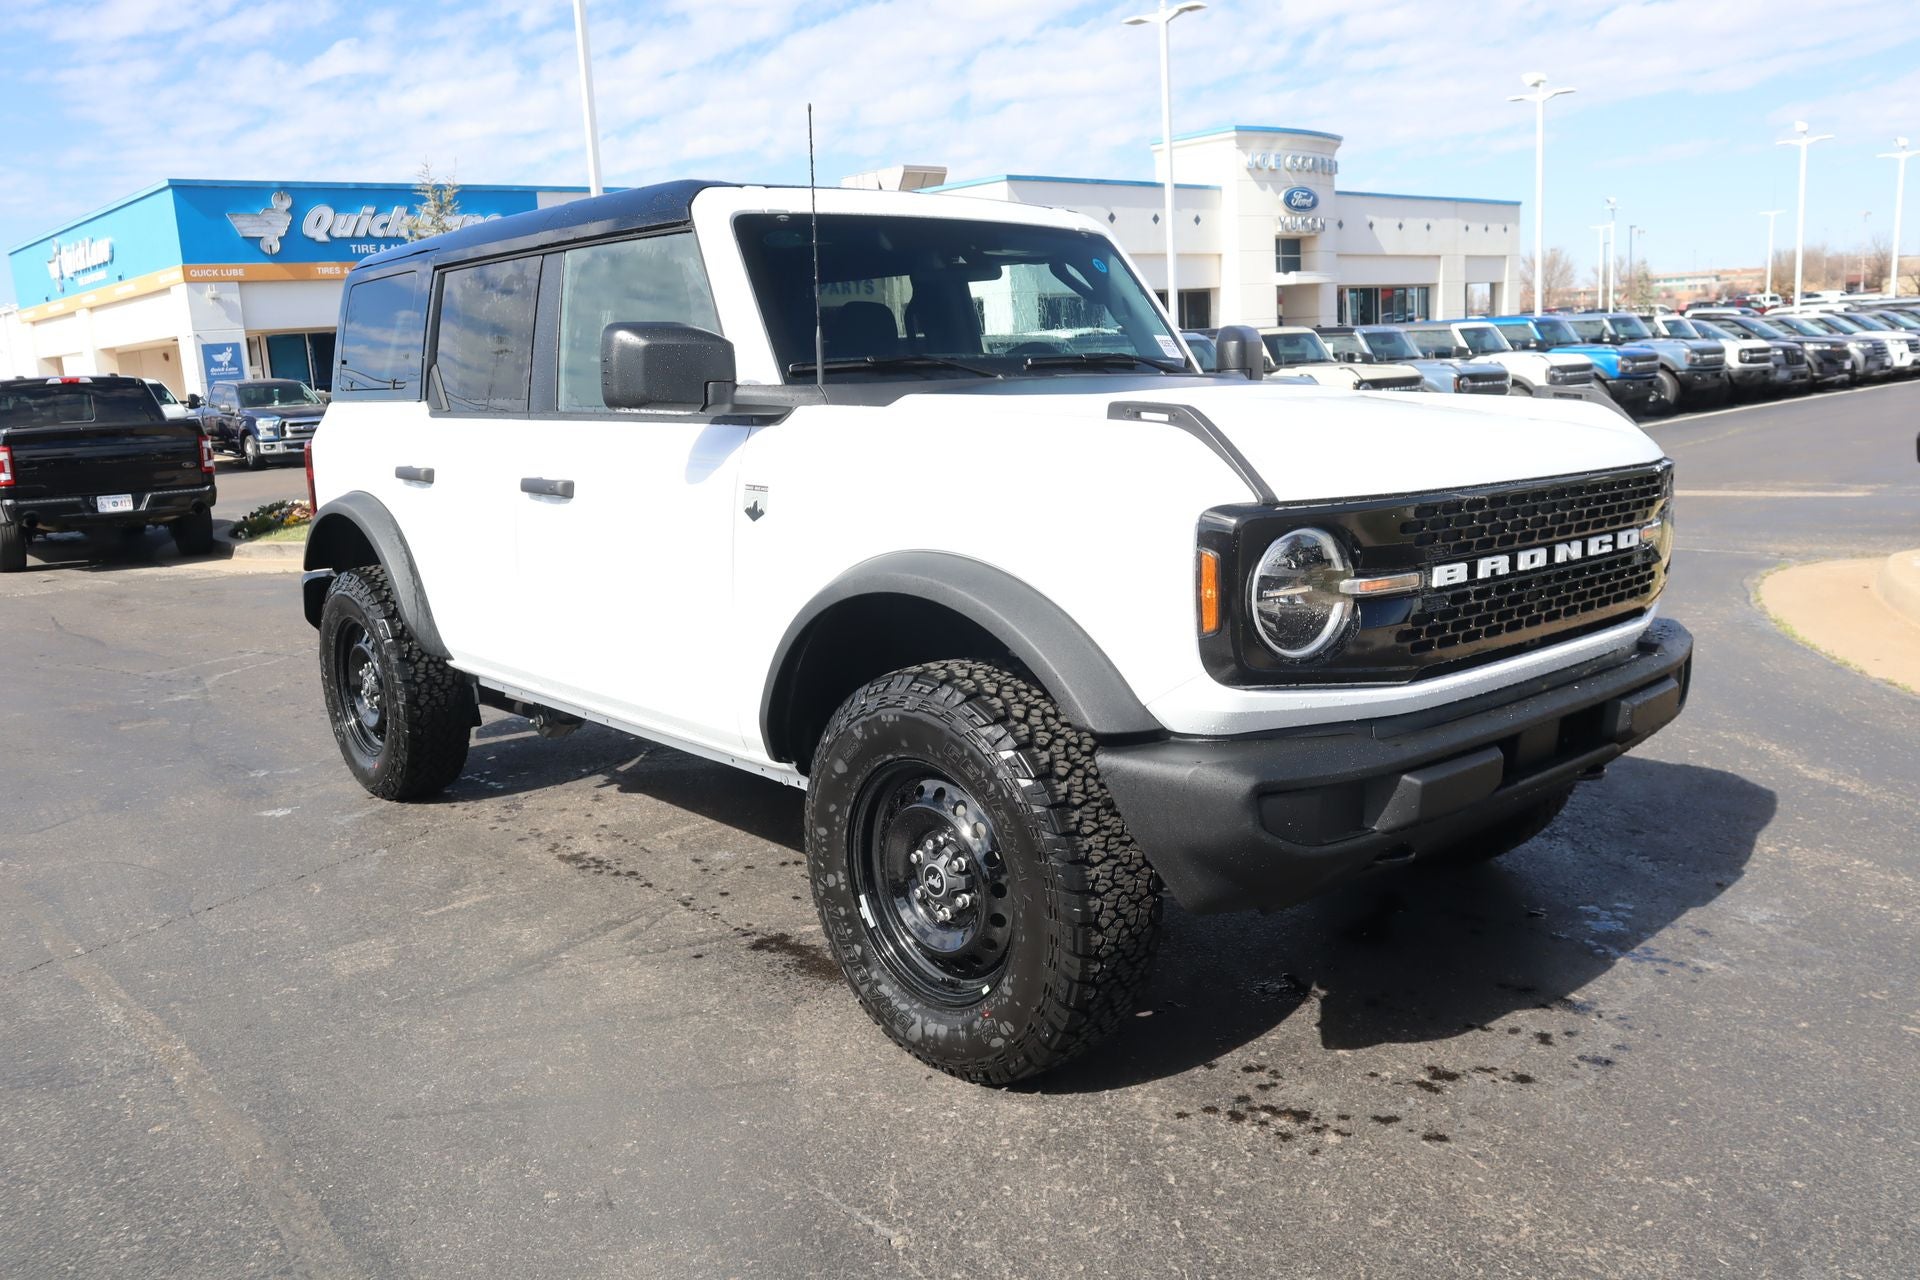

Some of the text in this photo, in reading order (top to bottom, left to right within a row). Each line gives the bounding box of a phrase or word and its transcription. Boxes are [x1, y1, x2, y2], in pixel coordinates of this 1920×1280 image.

[1247, 151, 1281, 170] JOE
[302, 203, 416, 242] Quick
[1279, 215, 1326, 232] YUKON
[350, 244, 377, 254] TIRE
[190, 268, 219, 277] QUICK
[220, 268, 244, 277] LUBE
[316, 267, 340, 275] TIRES
[819, 280, 875, 296] PARTS
[1432, 528, 1640, 589] BRONCO
